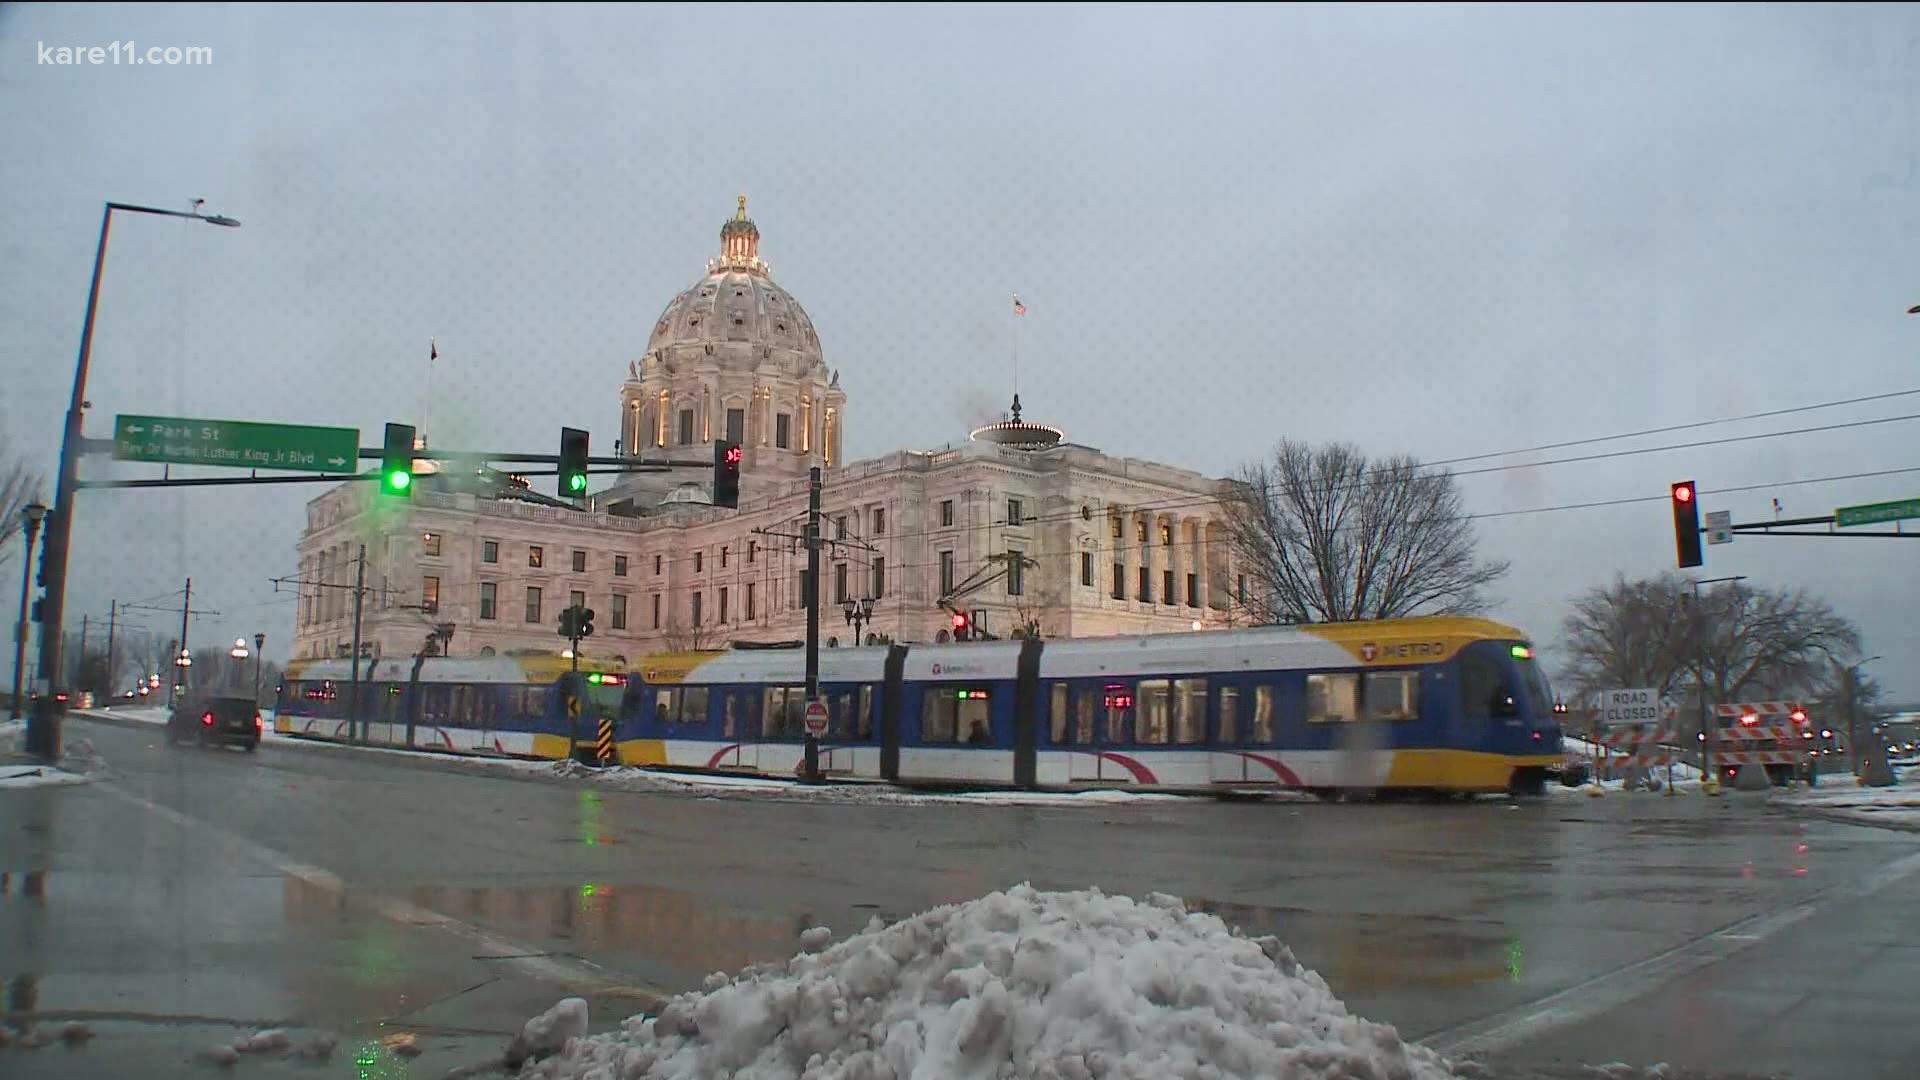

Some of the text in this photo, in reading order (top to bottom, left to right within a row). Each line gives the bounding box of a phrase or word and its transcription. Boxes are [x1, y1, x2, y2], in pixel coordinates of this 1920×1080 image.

[152, 424, 219, 440] Park St
[204, 446, 240, 459] Luther
[243, 448, 268, 464] King
[273, 449, 285, 461] Jr
[289, 450, 314, 463] Blvd
[1383, 642, 1444, 658] METRO
[1613, 693, 1647, 704] ROAD
[1608, 708, 1656, 720] CLOSED
